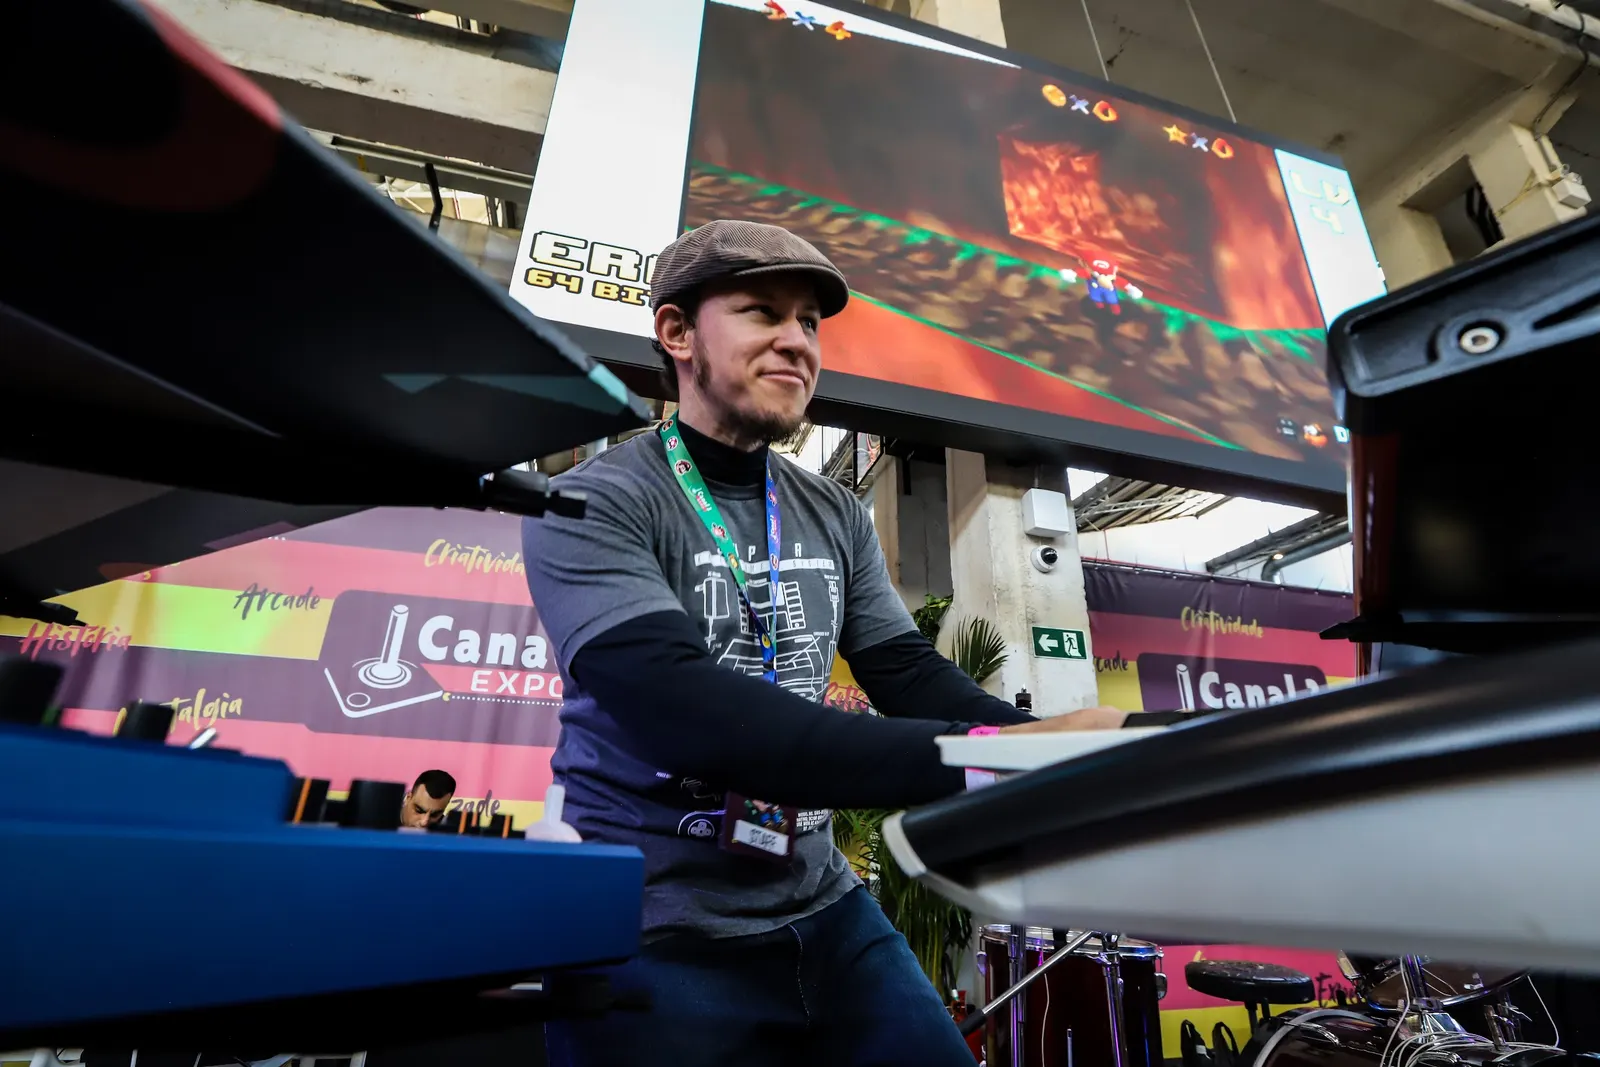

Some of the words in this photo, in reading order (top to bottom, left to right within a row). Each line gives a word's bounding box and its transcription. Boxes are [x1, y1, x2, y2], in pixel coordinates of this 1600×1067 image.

[524, 267, 583, 294] 64
[424, 539, 525, 577] Criativida
[233, 582, 320, 620] Arcade
[1181, 606, 1264, 638] Criatividade
[418, 615, 550, 670] Cana
[1093, 650, 1128, 672] cade
[450, 789, 500, 817] zade
